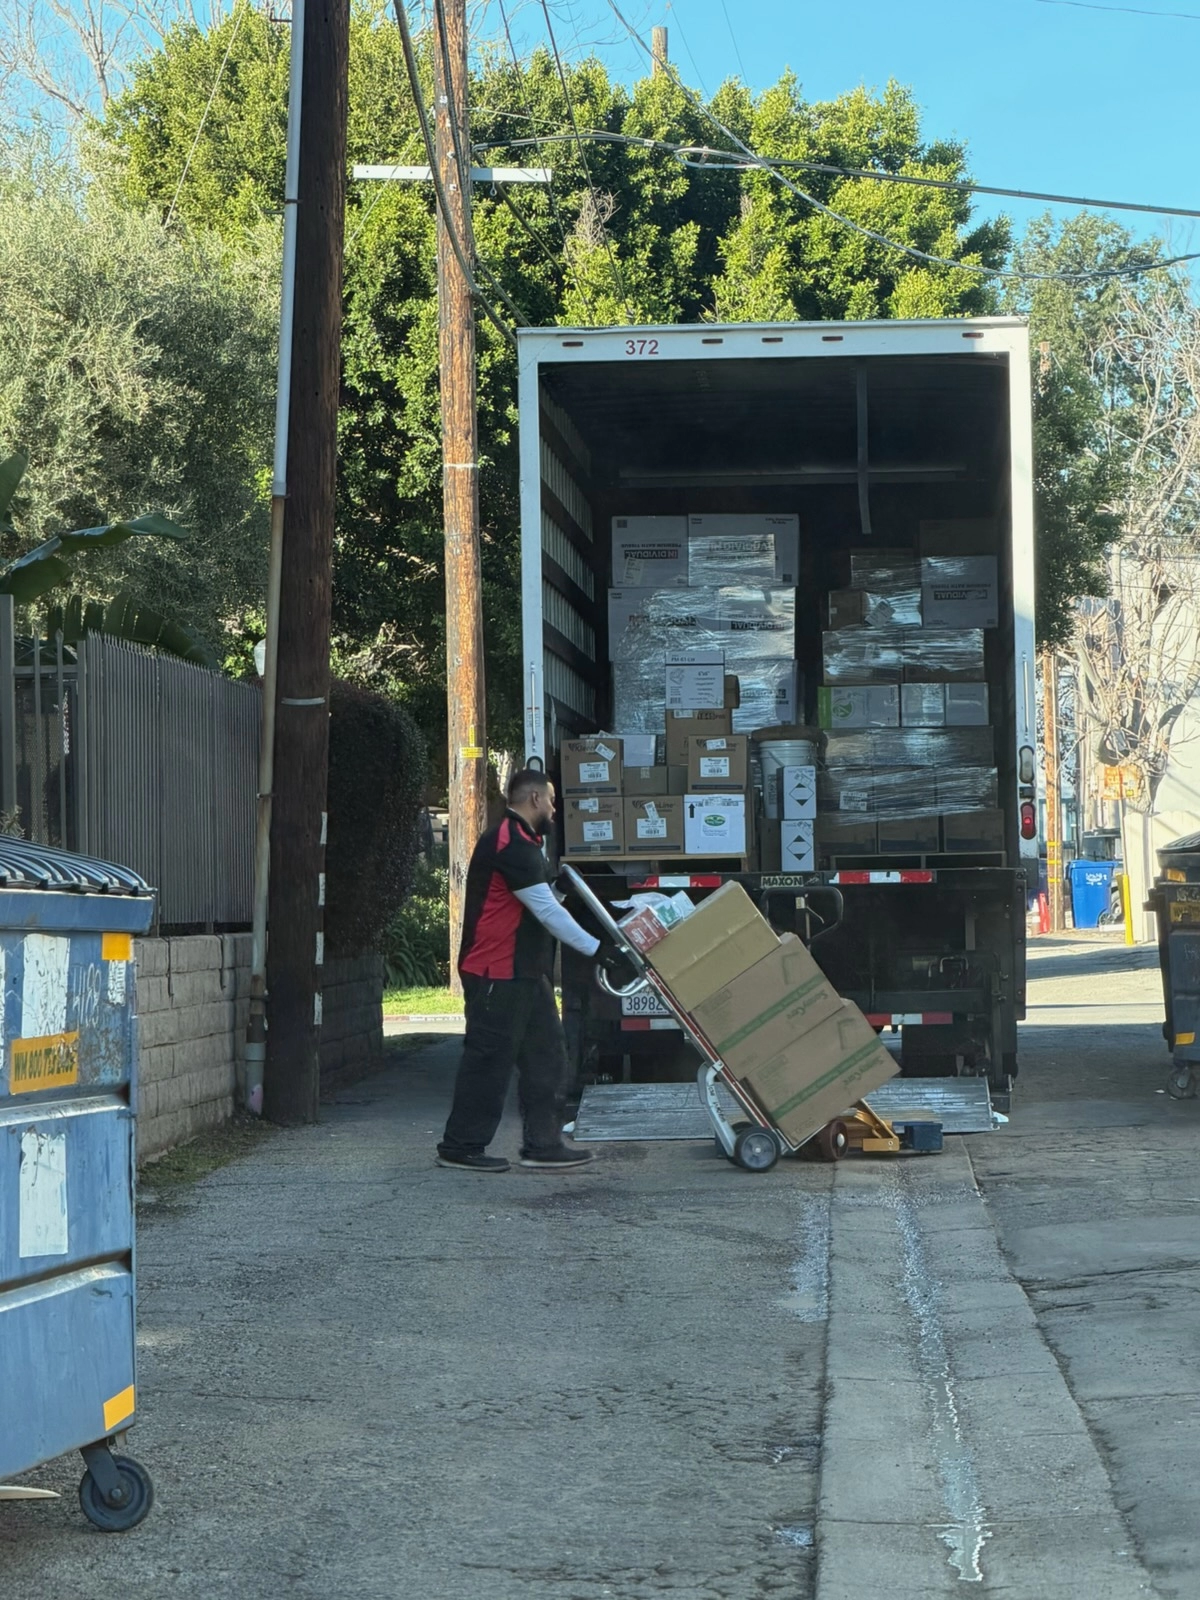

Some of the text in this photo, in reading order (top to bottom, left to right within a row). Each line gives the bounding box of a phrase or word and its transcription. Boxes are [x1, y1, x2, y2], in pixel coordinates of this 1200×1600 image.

[625, 339, 659, 356] 372
[762, 876, 802, 887] MAXON
[626, 996, 667, 1011] 38982
[14, 1051, 28, 1082] WM
[29, 1048, 43, 1080] 800
